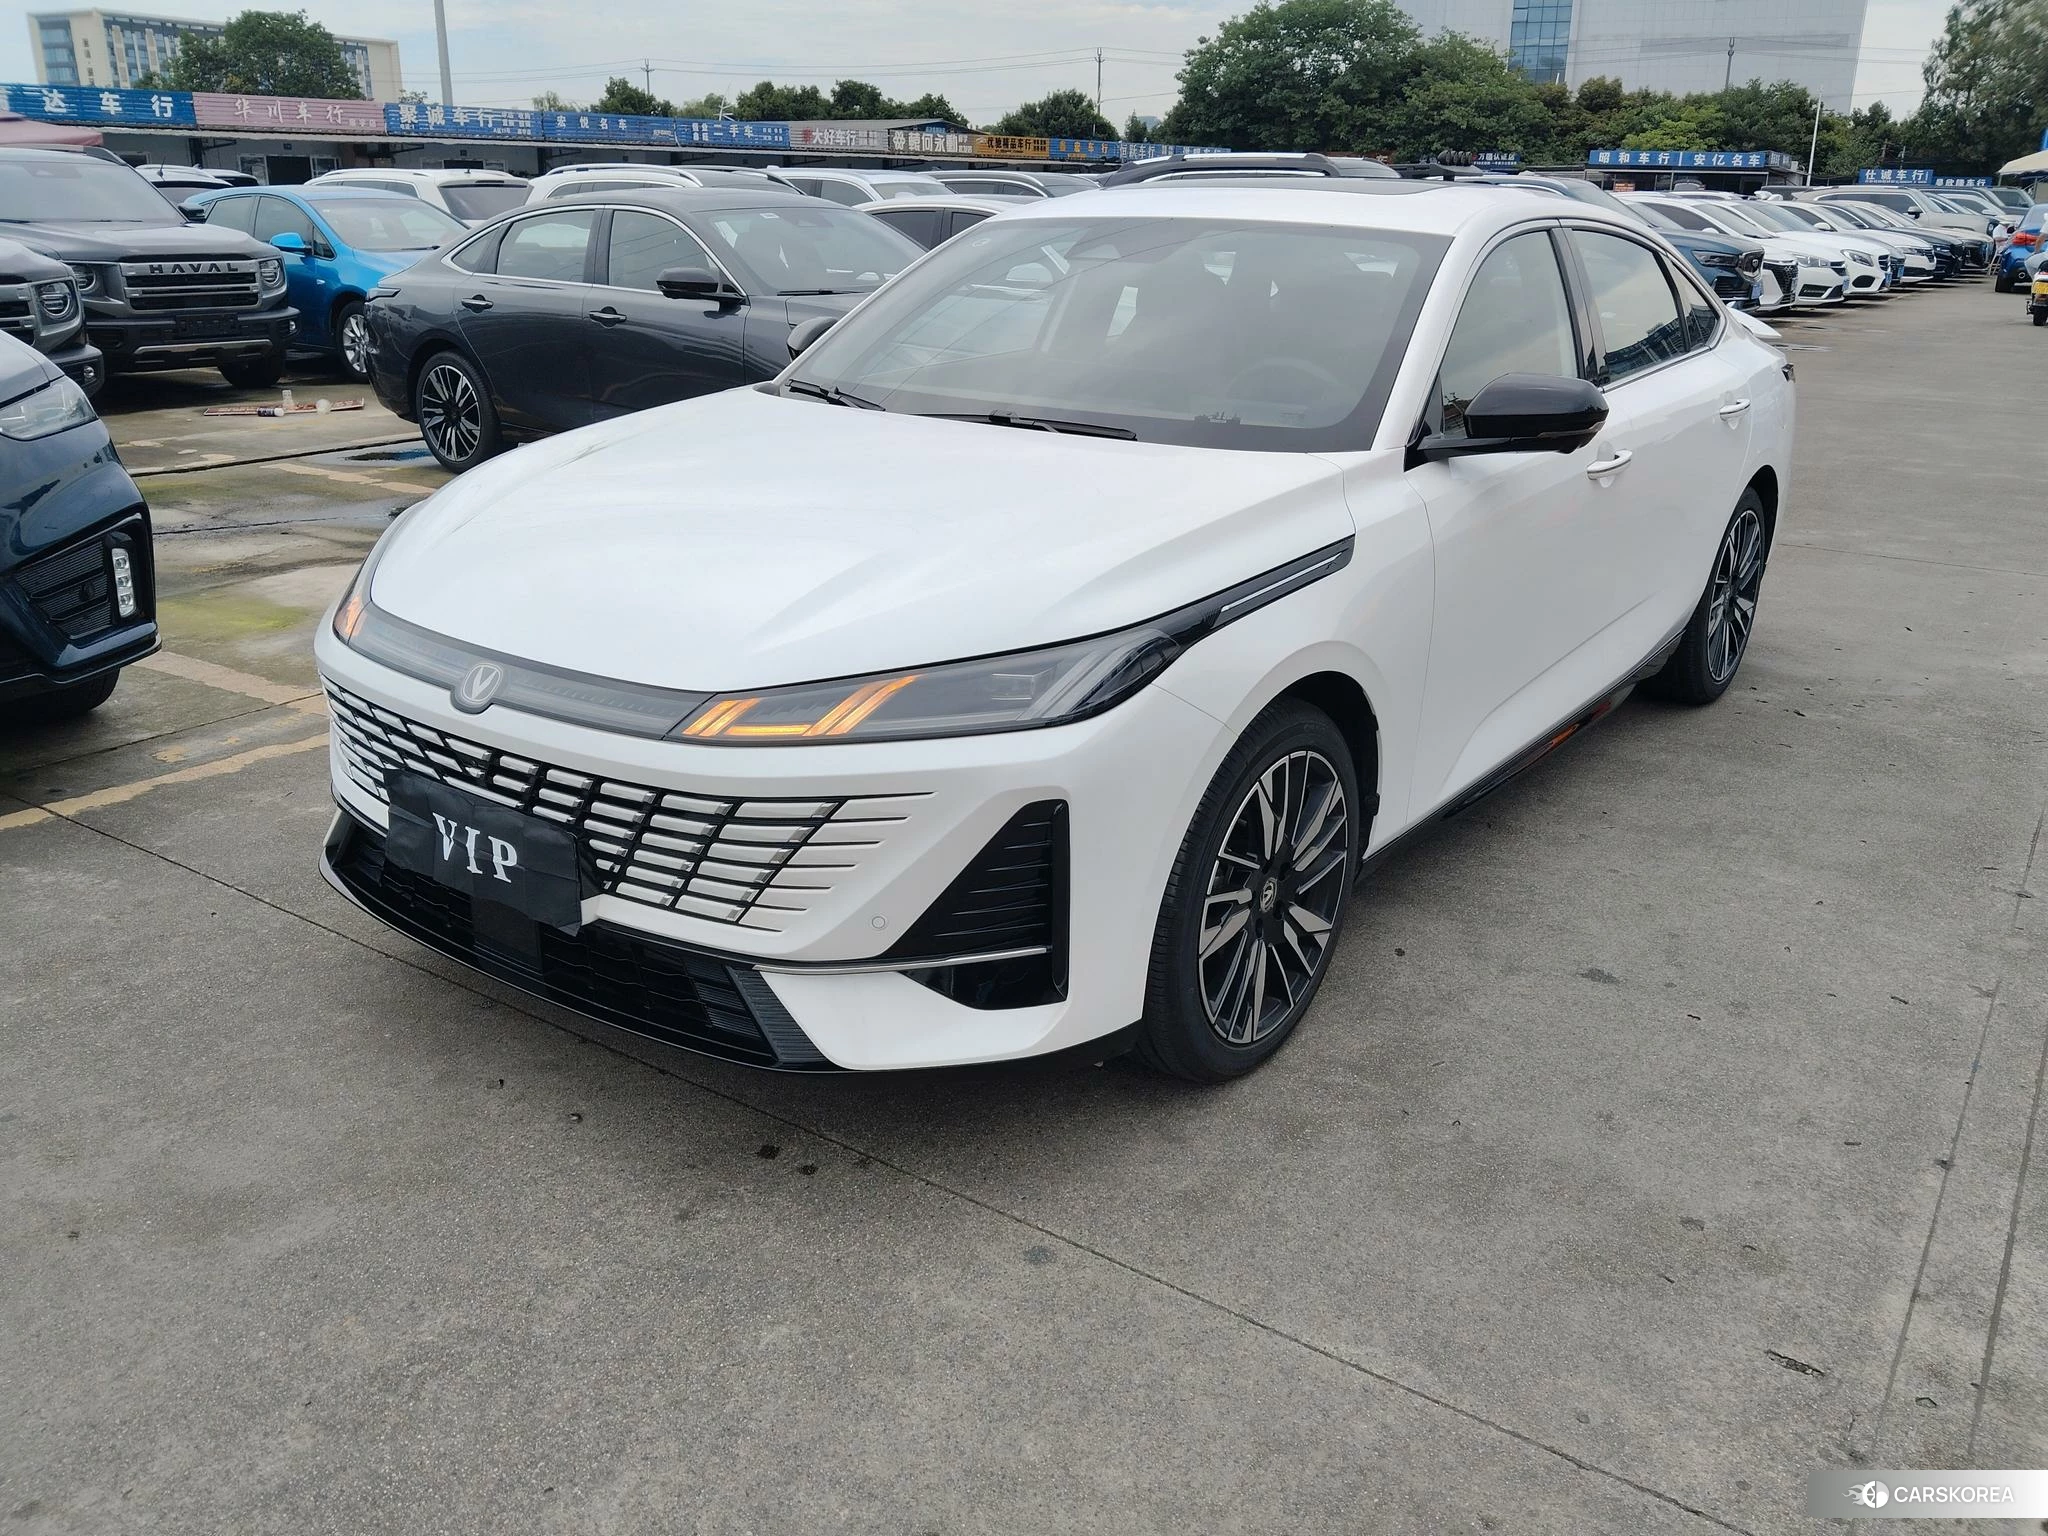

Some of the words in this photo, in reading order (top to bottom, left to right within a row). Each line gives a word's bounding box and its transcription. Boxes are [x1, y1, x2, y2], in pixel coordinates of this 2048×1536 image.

[234, 98, 344, 125] 华川车行
[398, 104, 495, 130] 聚诚车行
[556, 115, 628, 130] 宏悦名车
[713, 124, 753, 139] 二手车
[812, 128, 857, 146] 大好车行
[1598, 152, 1670, 165] 昭和车行
[1693, 153, 1761, 167] 安亿名车
[1865, 169, 1924, 181] 仕诚车行
[149, 263, 238, 275] HAVAL
[432, 812, 518, 883] VIP
